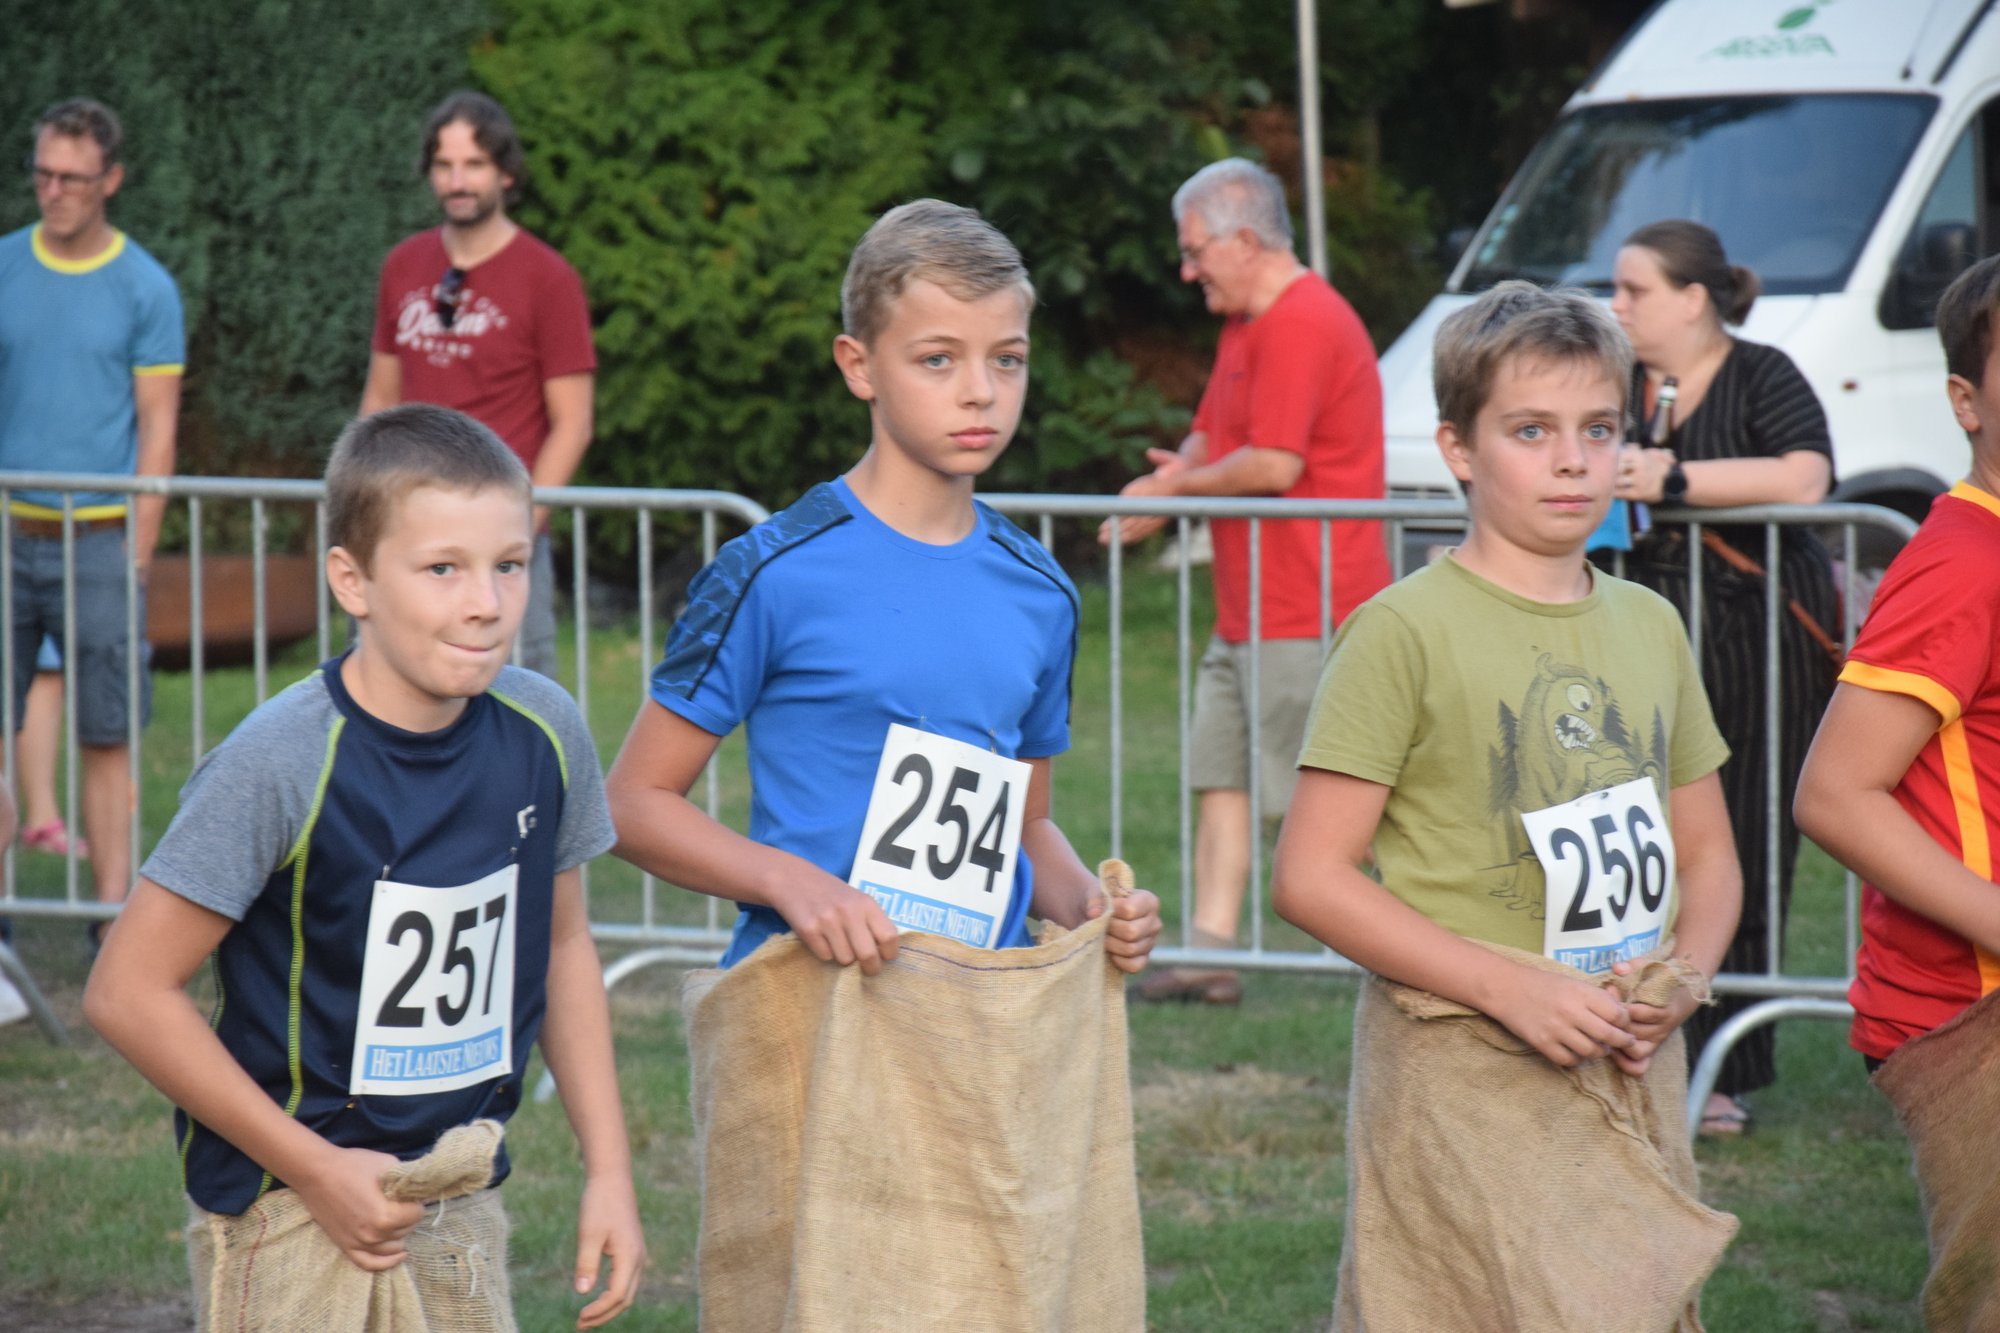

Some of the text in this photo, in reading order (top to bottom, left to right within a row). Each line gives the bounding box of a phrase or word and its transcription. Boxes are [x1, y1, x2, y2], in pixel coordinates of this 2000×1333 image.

[871, 753, 1009, 893] 254
[1550, 805, 1666, 932] 256
[374, 893, 506, 1028] 257
[888, 893, 946, 931] LAATSTE
[944, 908, 989, 946] NIEUWS
[370, 1035, 499, 1077] HET LAATSTE NIEUWS
